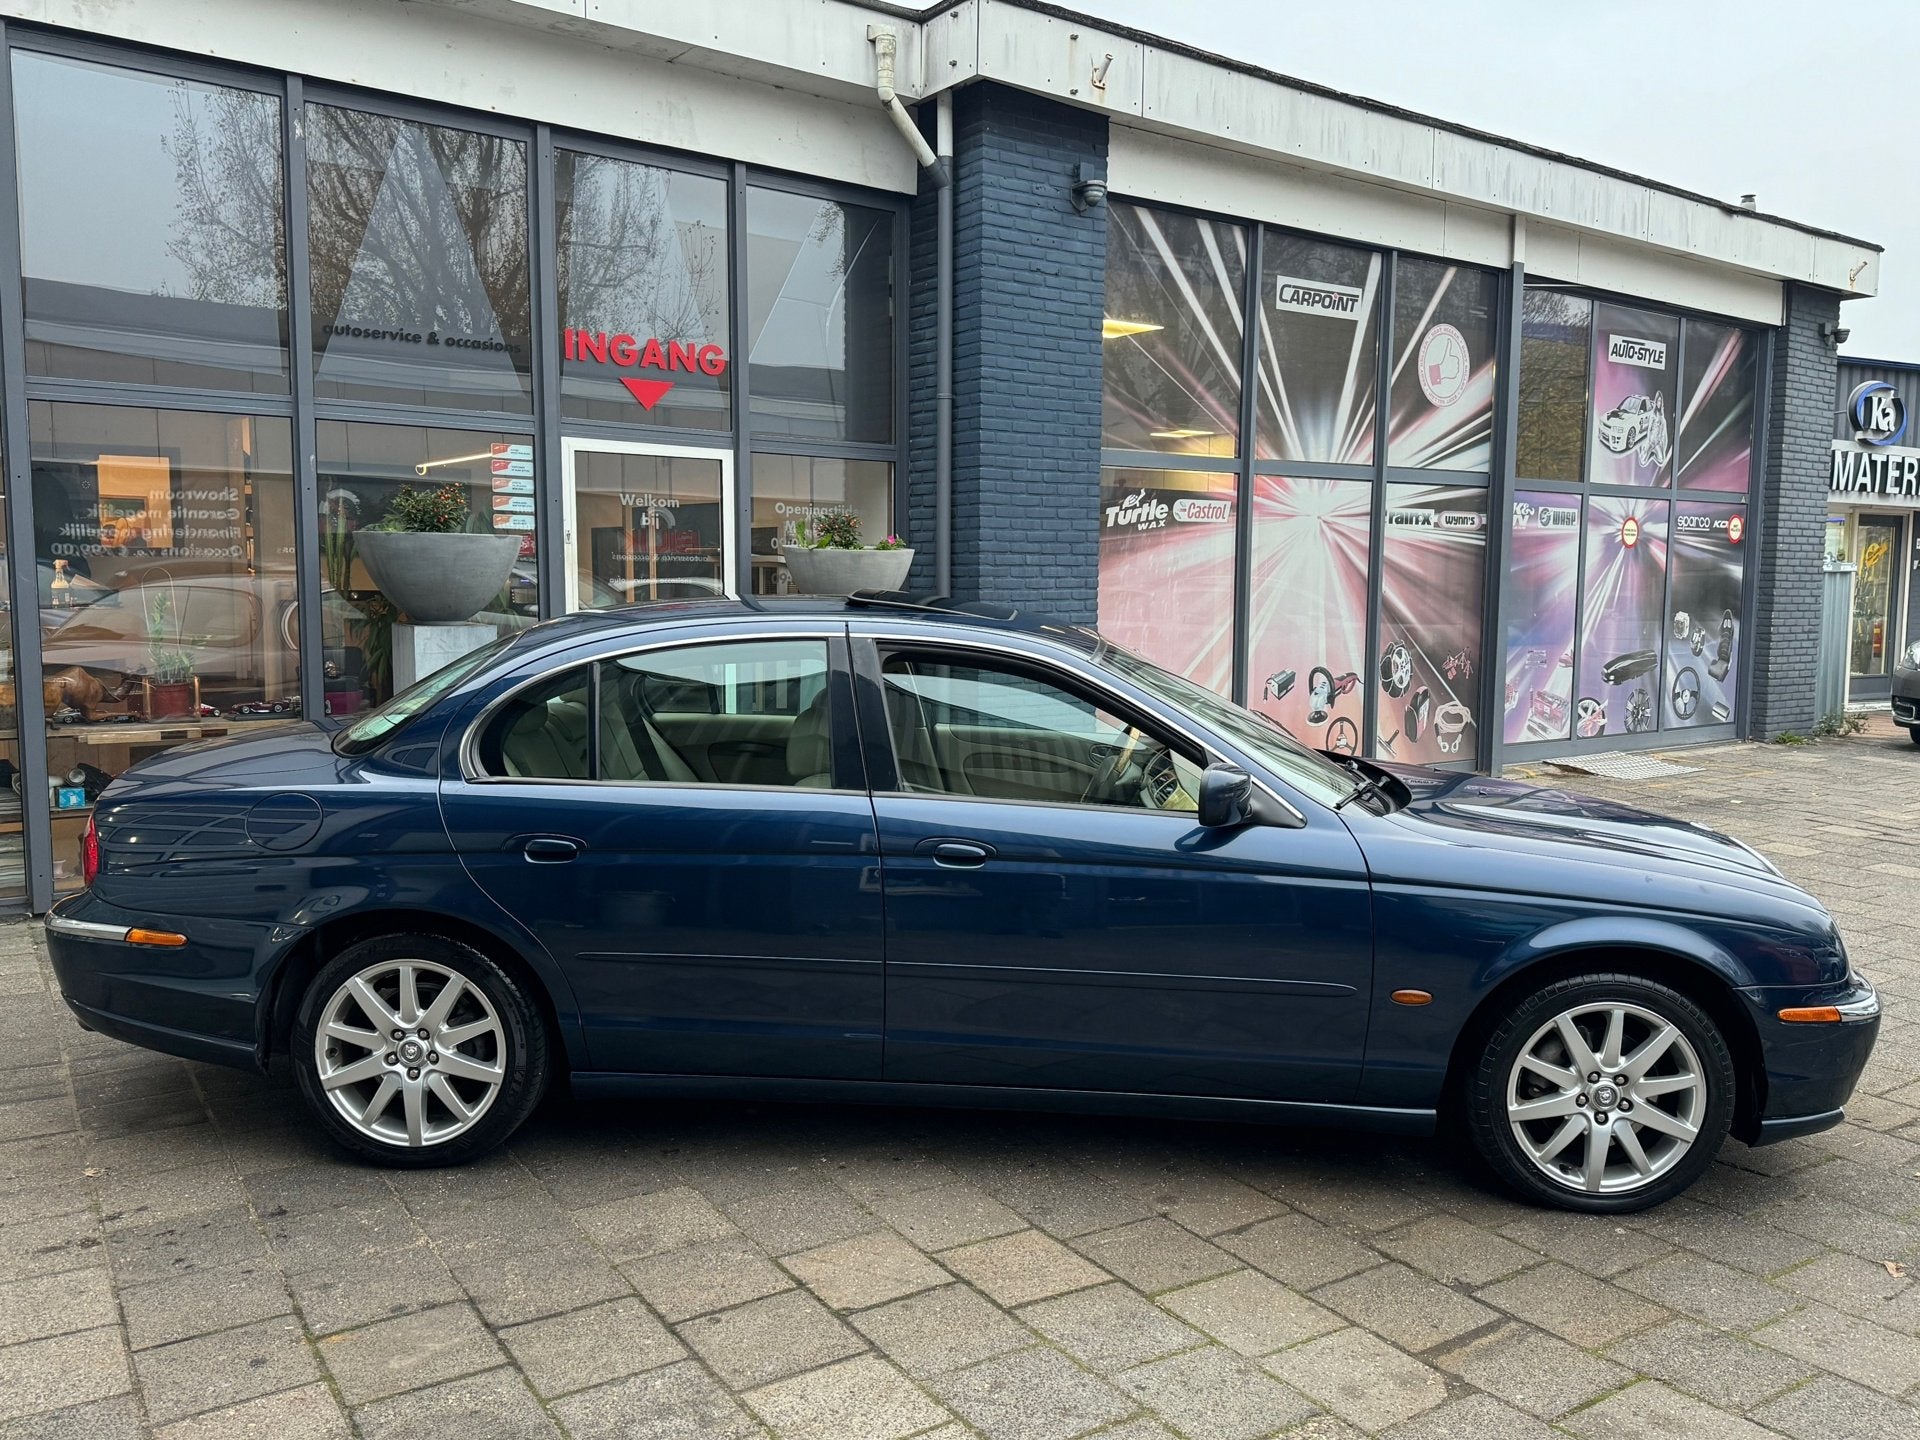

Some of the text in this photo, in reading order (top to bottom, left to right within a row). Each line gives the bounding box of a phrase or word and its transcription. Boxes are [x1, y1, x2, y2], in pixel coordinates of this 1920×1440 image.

[323, 323, 521, 353] autoservice & occasions
[564, 327, 727, 376] INGANG
[1610, 339, 1664, 364] AUTO-STYLE
[1832, 450, 1920, 496] MATER
[619, 493, 680, 508] Welkom
[1105, 499, 1169, 528] Turtle
[1187, 502, 1227, 520] Castrol
[1552, 510, 1577, 526] WASP
[641, 512, 660, 530] bij
[1137, 520, 1166, 531] WAX
[1677, 516, 1710, 531] sparco
